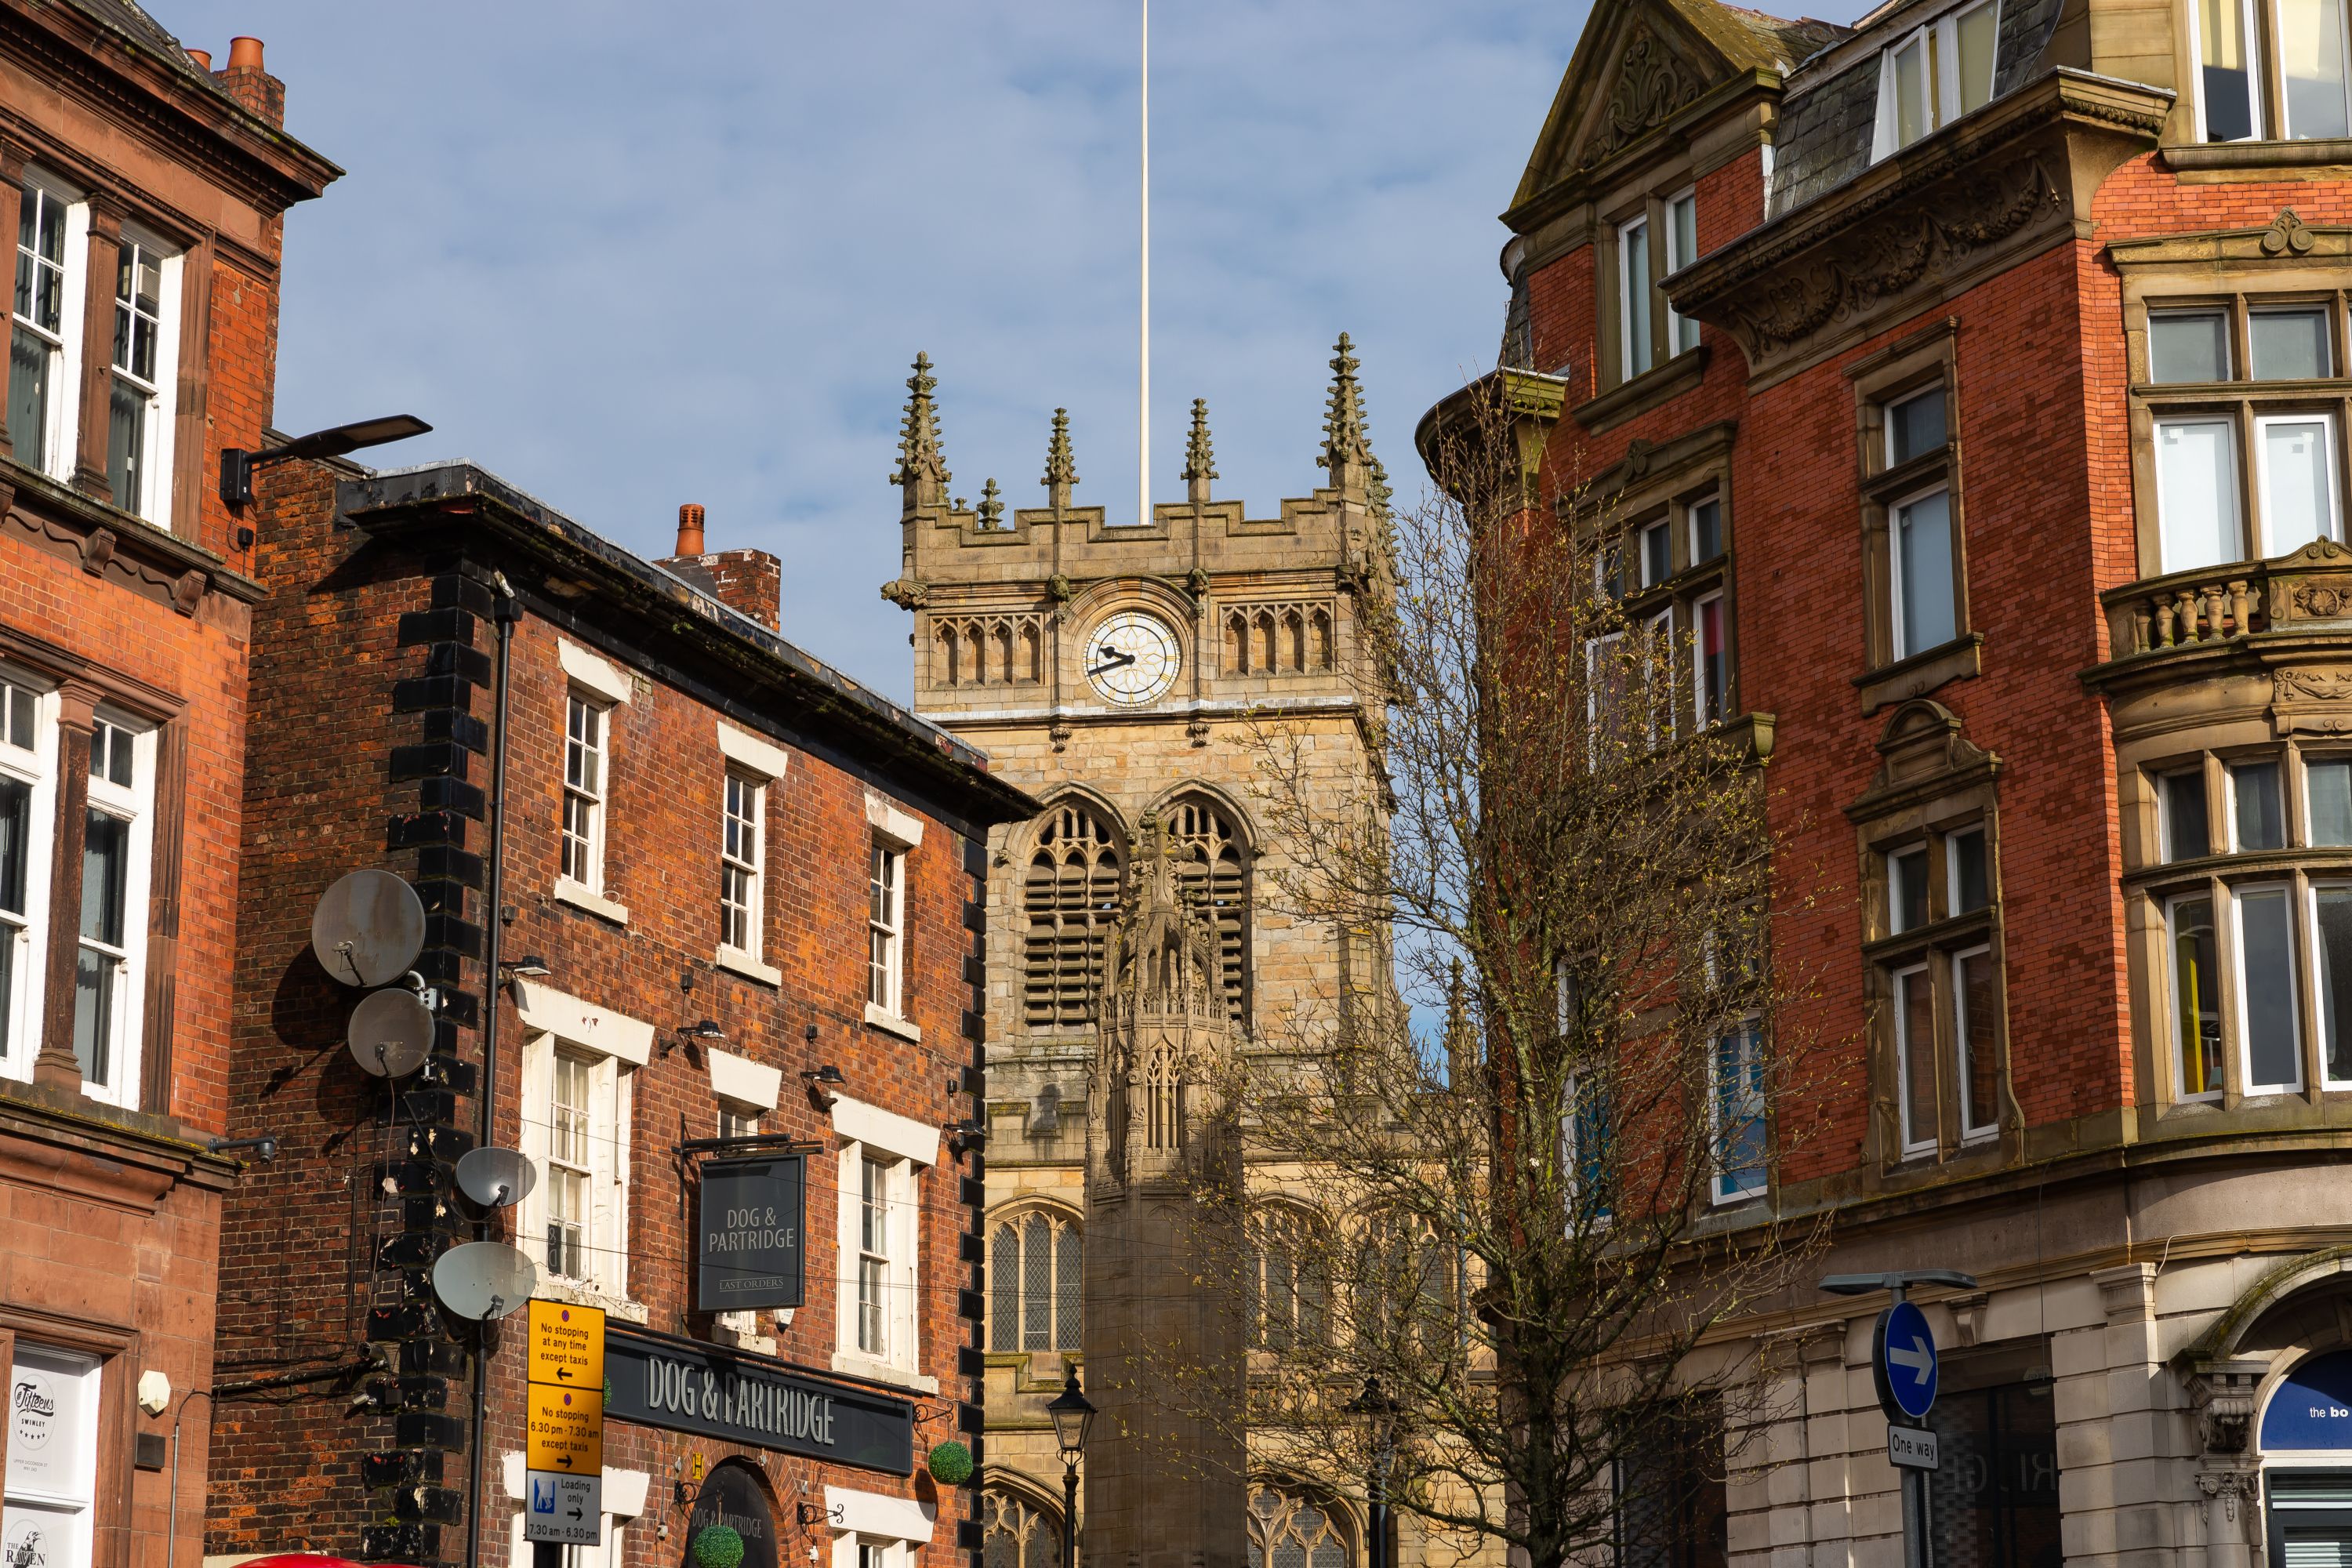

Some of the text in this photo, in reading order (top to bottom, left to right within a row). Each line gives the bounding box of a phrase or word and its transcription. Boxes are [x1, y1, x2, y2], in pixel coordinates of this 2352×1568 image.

[728, 1207, 776, 1229] DOG &
[710, 1228, 794, 1252] PARTRIDGE
[720, 1278, 783, 1290] LAST ORDERS
[541, 1323, 589, 1340] No stopping
[543, 1337, 586, 1351] at any time
[541, 1352, 588, 1366] except taxis
[15, 1382, 54, 1414] Fifteens
[649, 1355, 835, 1445] DOG & PARTRIDGE
[542, 1406, 589, 1423] No stopping
[2310, 1406, 2349, 1417] the bo
[21, 1418, 45, 1427] SWINLEY
[531, 1421, 550, 1432] 6.30
[551, 1426, 563, 1435] pm
[568, 1426, 586, 1437] 7.30
[588, 1430, 599, 1439] am
[542, 1439, 589, 1452] except taxis
[1893, 1433, 1935, 1461] One way
[561, 1478, 590, 1493] Loading
[567, 1494, 583, 1505] only
[692, 1508, 709, 1528] DOG
[710, 1510, 717, 1526] &
[529, 1524, 547, 1535] 7.30
[566, 1527, 584, 1537] 6.30
[586, 1531, 597, 1541] pm
[5, 1549, 46, 1566] RAVEN
